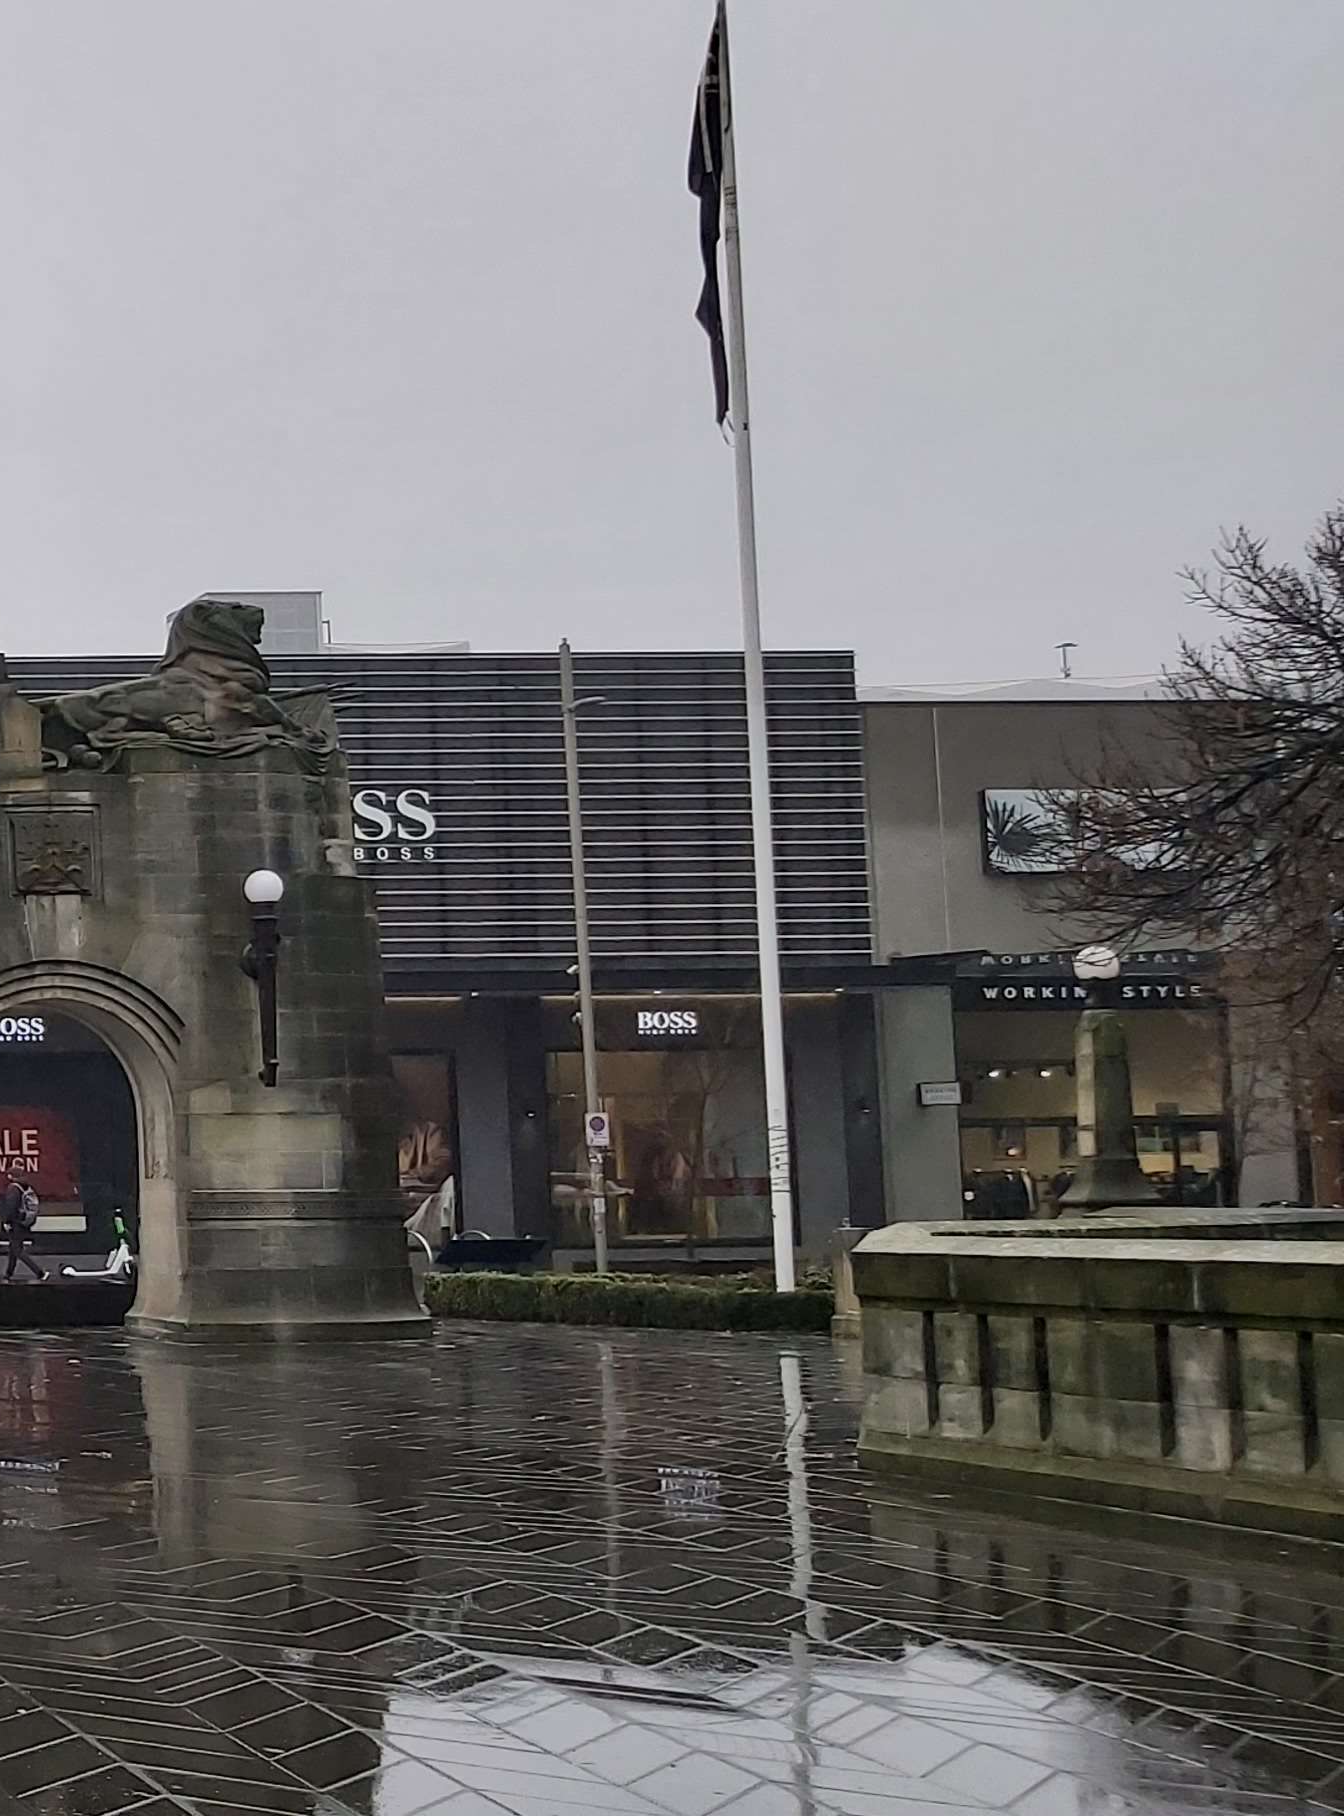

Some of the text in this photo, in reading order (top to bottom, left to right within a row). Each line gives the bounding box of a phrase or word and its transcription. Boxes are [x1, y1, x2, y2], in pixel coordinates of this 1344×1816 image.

[353, 789, 436, 841] SS
[353, 847, 435, 861] BOSS
[982, 986, 1202, 999] WORKIN STYLE
[637, 1011, 697, 1029] BOSS
